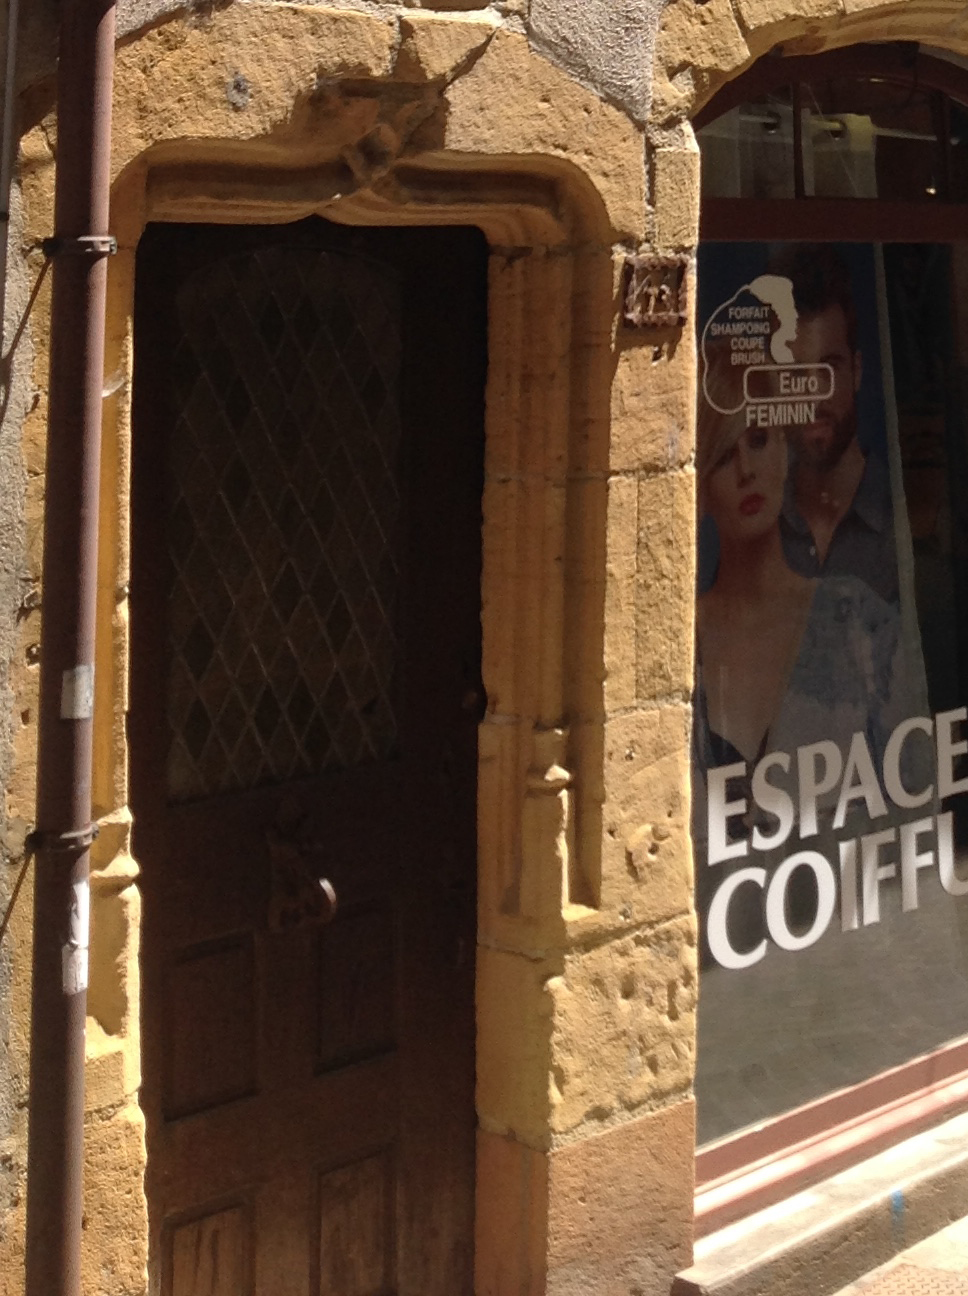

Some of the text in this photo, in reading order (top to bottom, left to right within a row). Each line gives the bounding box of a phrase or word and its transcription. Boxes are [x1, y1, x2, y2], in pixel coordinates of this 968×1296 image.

[728, 306, 770, 320] FORFAIT
[710, 321, 770, 336] SHAMPOING
[730, 336, 765, 351] COUPE
[730, 351, 765, 366] BRUSH
[779, 371, 818, 394] Euro
[745, 402, 816, 428] FEMININ
